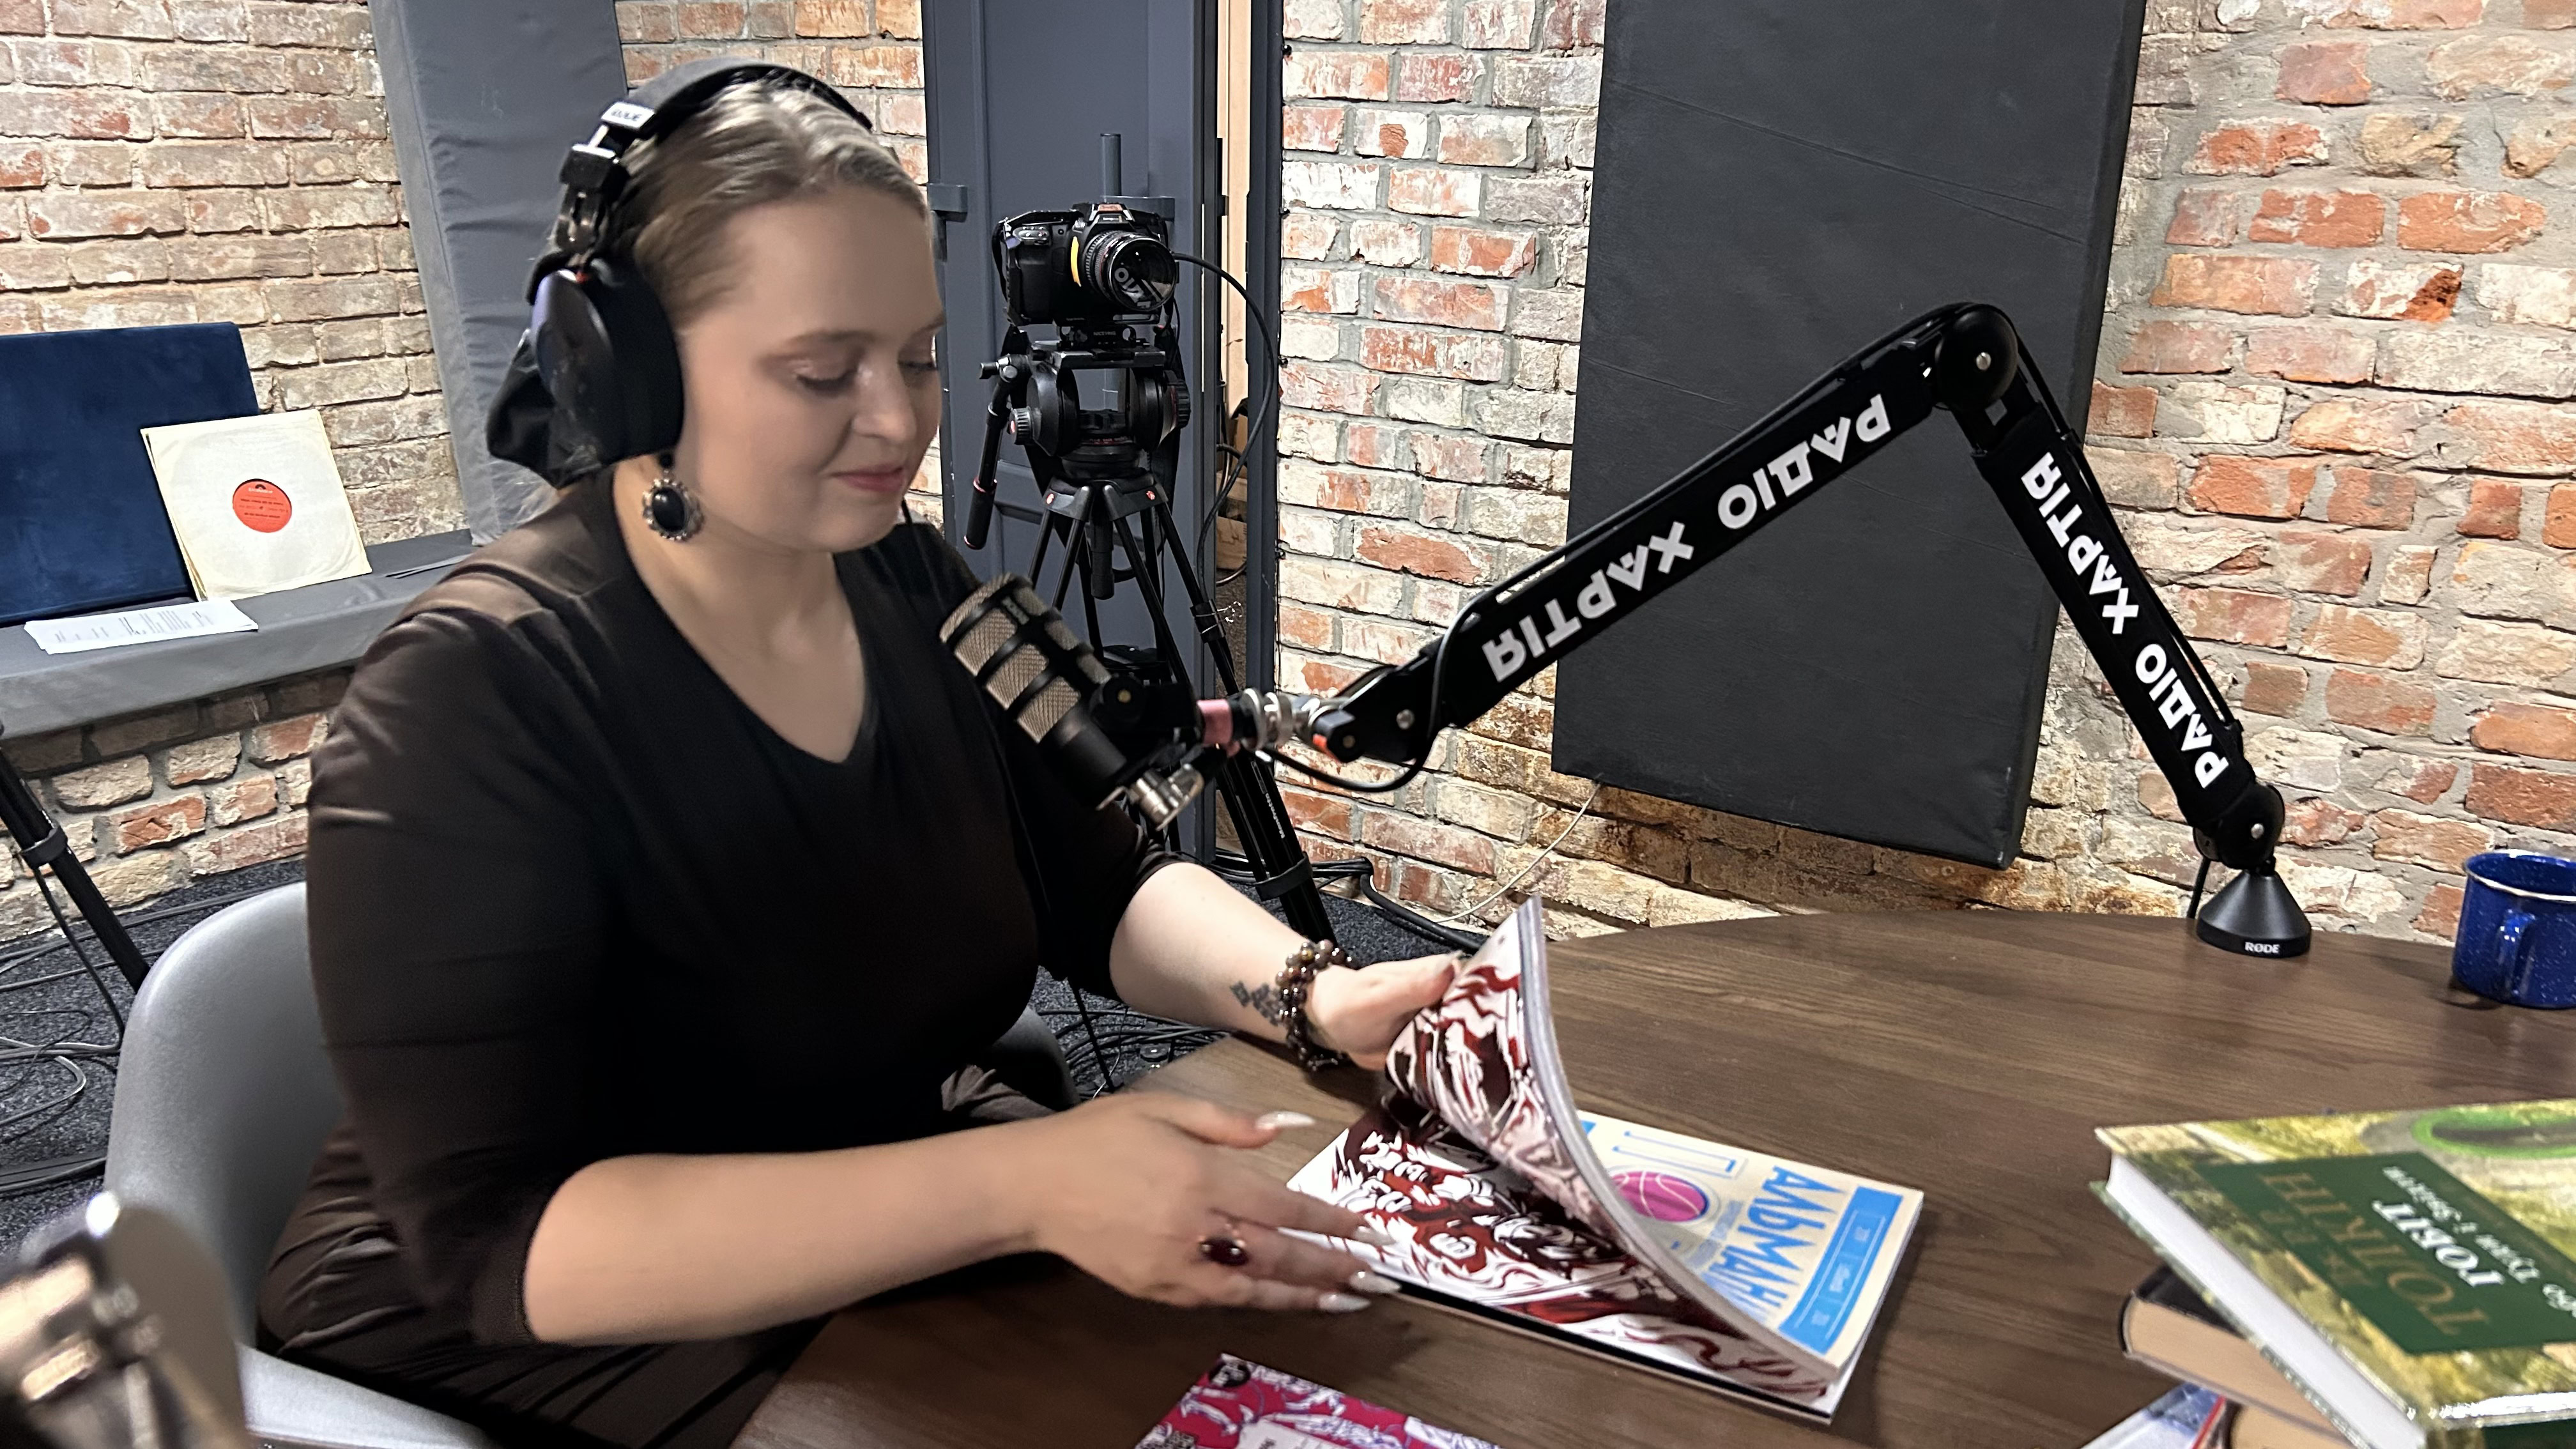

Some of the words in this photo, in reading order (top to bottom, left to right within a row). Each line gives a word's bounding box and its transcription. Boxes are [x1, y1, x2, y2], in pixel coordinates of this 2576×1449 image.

[1718, 394, 1890, 529] РАДІО
[1482, 521, 1693, 682] ХАРТІЯ
[2021, 452, 2139, 634] ХАРТІЯ
[2135, 643, 2229, 788] РАДІО
[1265, 793, 1285, 839] Manfrotto
[1699, 1165, 1846, 1321] АЛЬМАН
[2259, 1172, 2487, 1335] ТОЛКІН
[2372, 1200, 2504, 1287] ГОБІТ
